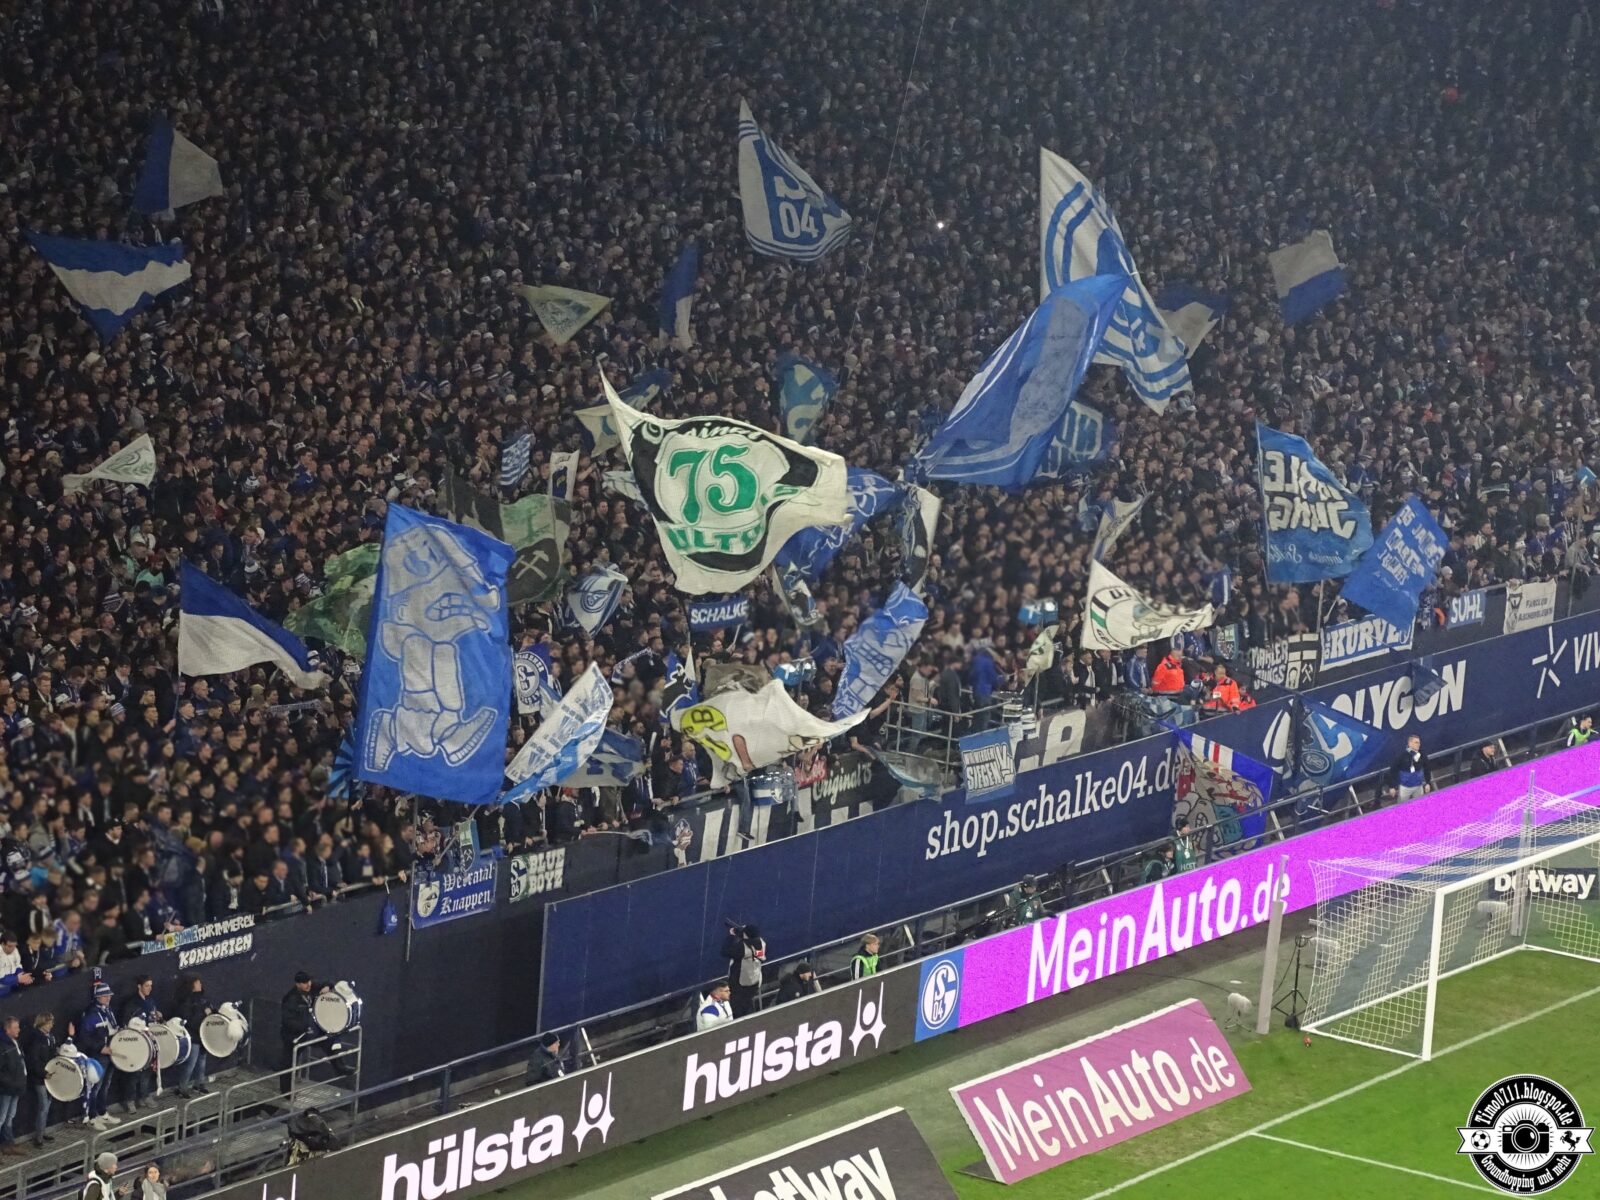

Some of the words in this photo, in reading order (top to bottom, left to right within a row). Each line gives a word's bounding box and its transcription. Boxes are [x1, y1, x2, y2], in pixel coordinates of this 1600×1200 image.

[779, 201, 819, 239] 04
[667, 444, 757, 525] 75
[691, 601, 747, 624] SCHALKE
[1451, 593, 1482, 623] SUHL
[1322, 660, 1466, 730] LYGON
[813, 762, 861, 805] Original
[529, 848, 565, 874] BLUE
[440, 890, 490, 915] Knappen
[529, 869, 563, 896] BOYZ
[1494, 868, 1596, 899] betway
[178, 932, 254, 969] KONSORTEN
[1026, 864, 1290, 1003] MeinAuto.de
[683, 1020, 842, 1111] hülsta
[974, 1037, 1235, 1171] MeinAuto.de
[381, 1114, 564, 1200] hülsta
[709, 1147, 897, 1200] tway
